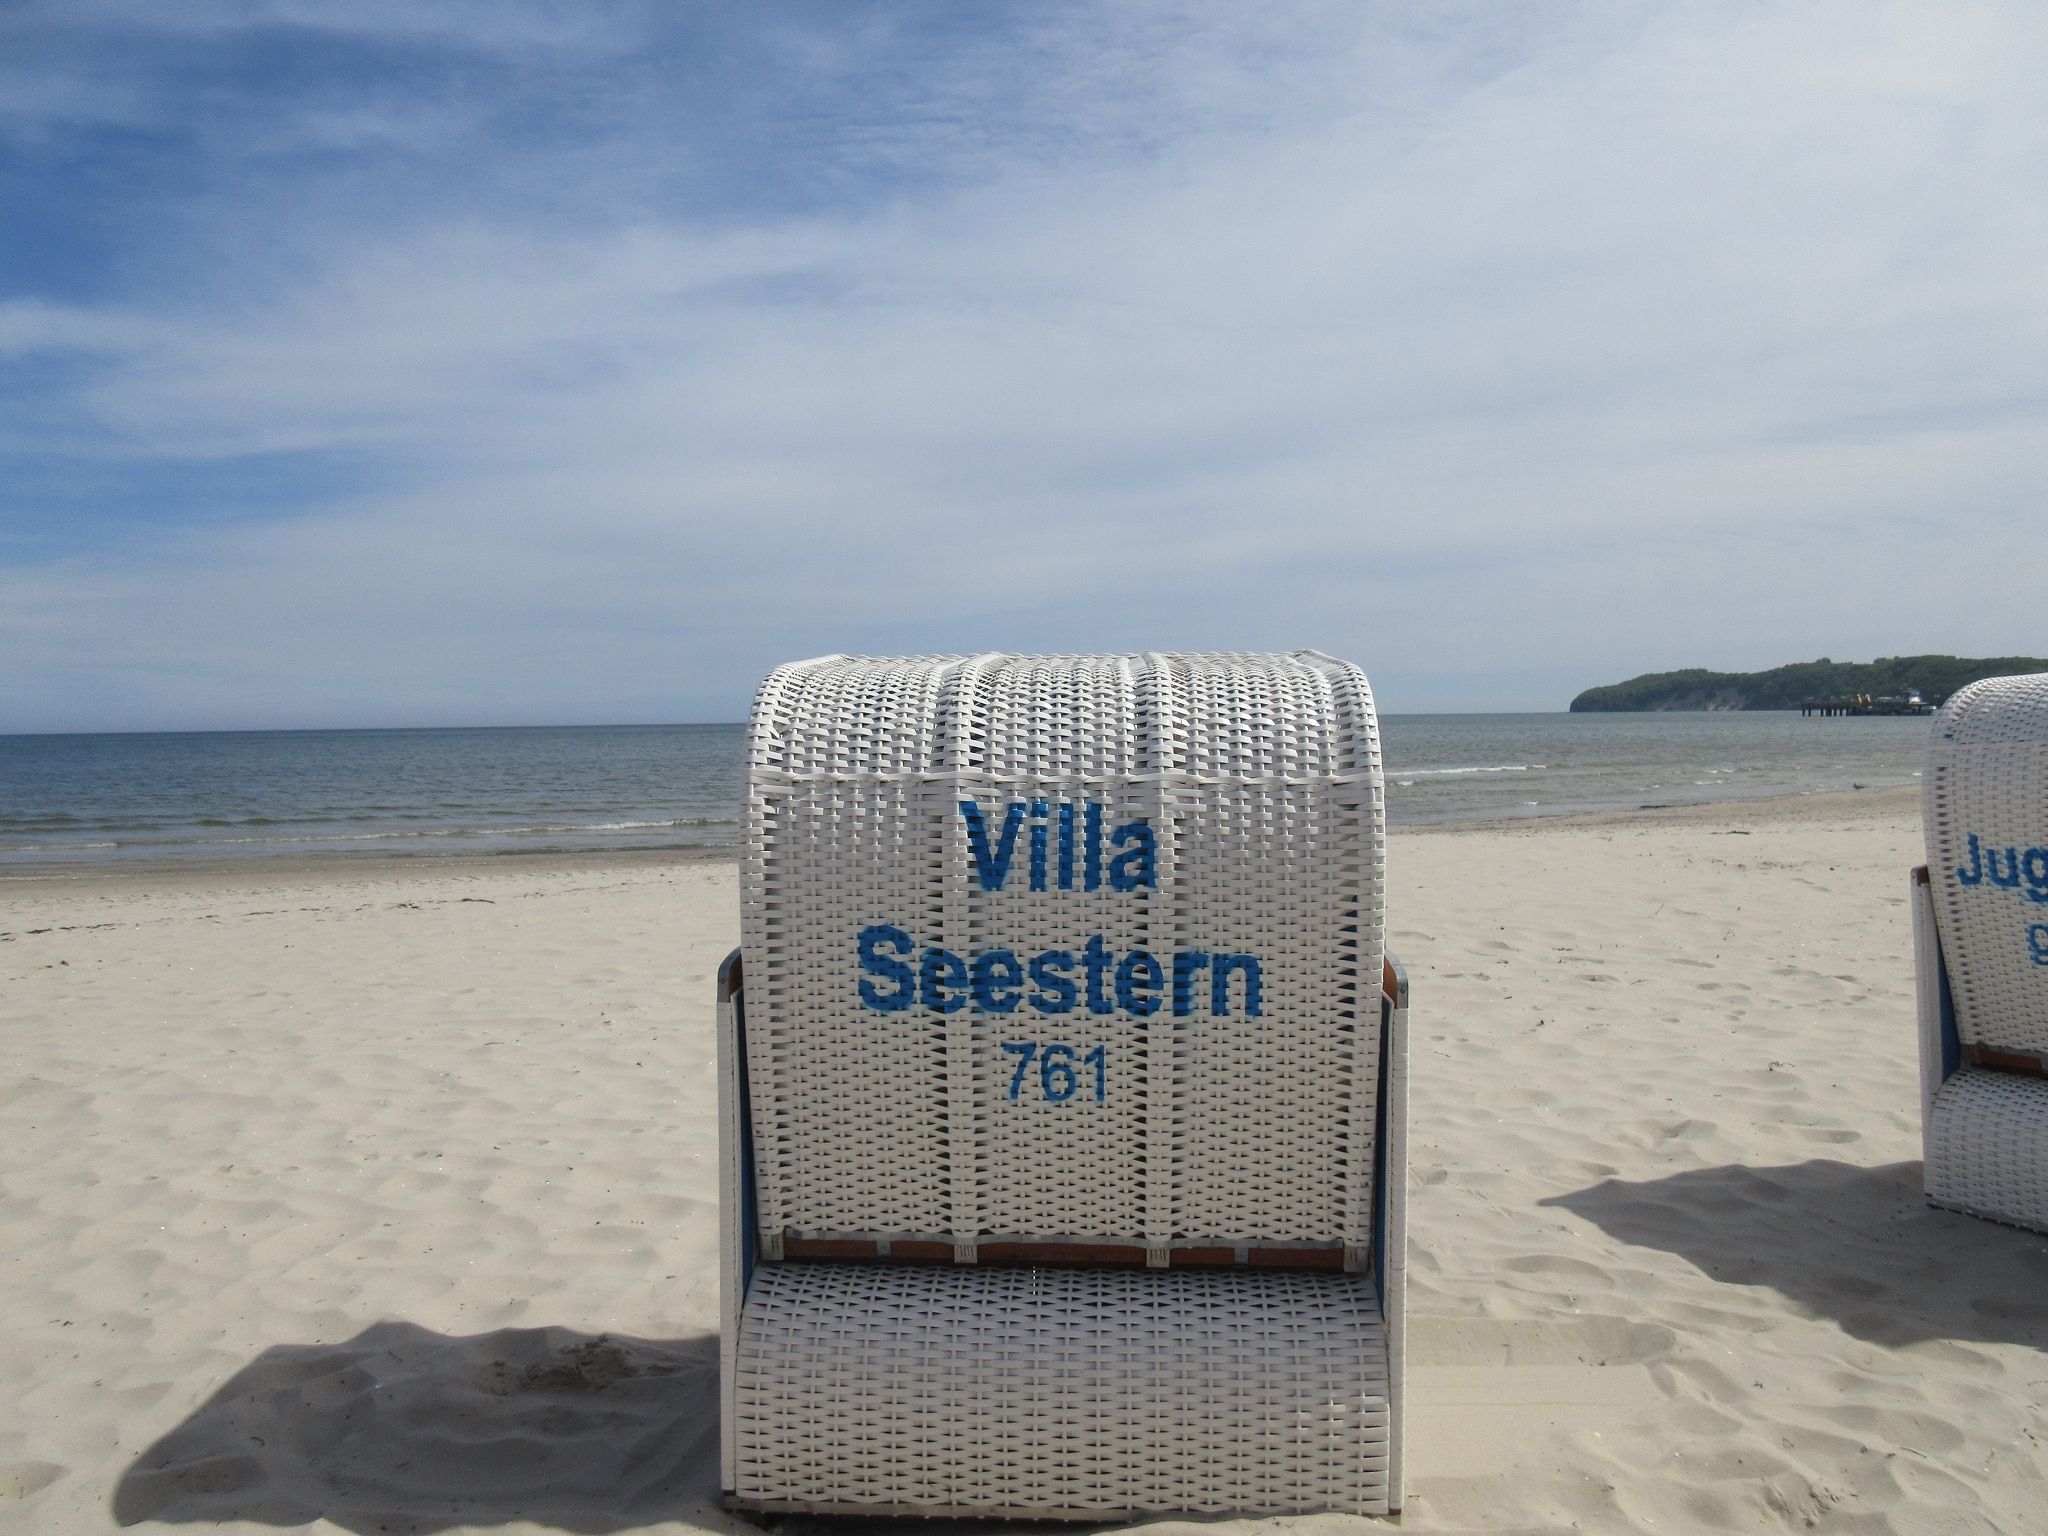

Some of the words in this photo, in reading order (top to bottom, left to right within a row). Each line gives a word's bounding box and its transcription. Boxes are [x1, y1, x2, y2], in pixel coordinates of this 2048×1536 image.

[960, 800, 1157, 892] Villa
[857, 923, 1263, 1017] Seestern
[1002, 1042, 1106, 1102] 761
